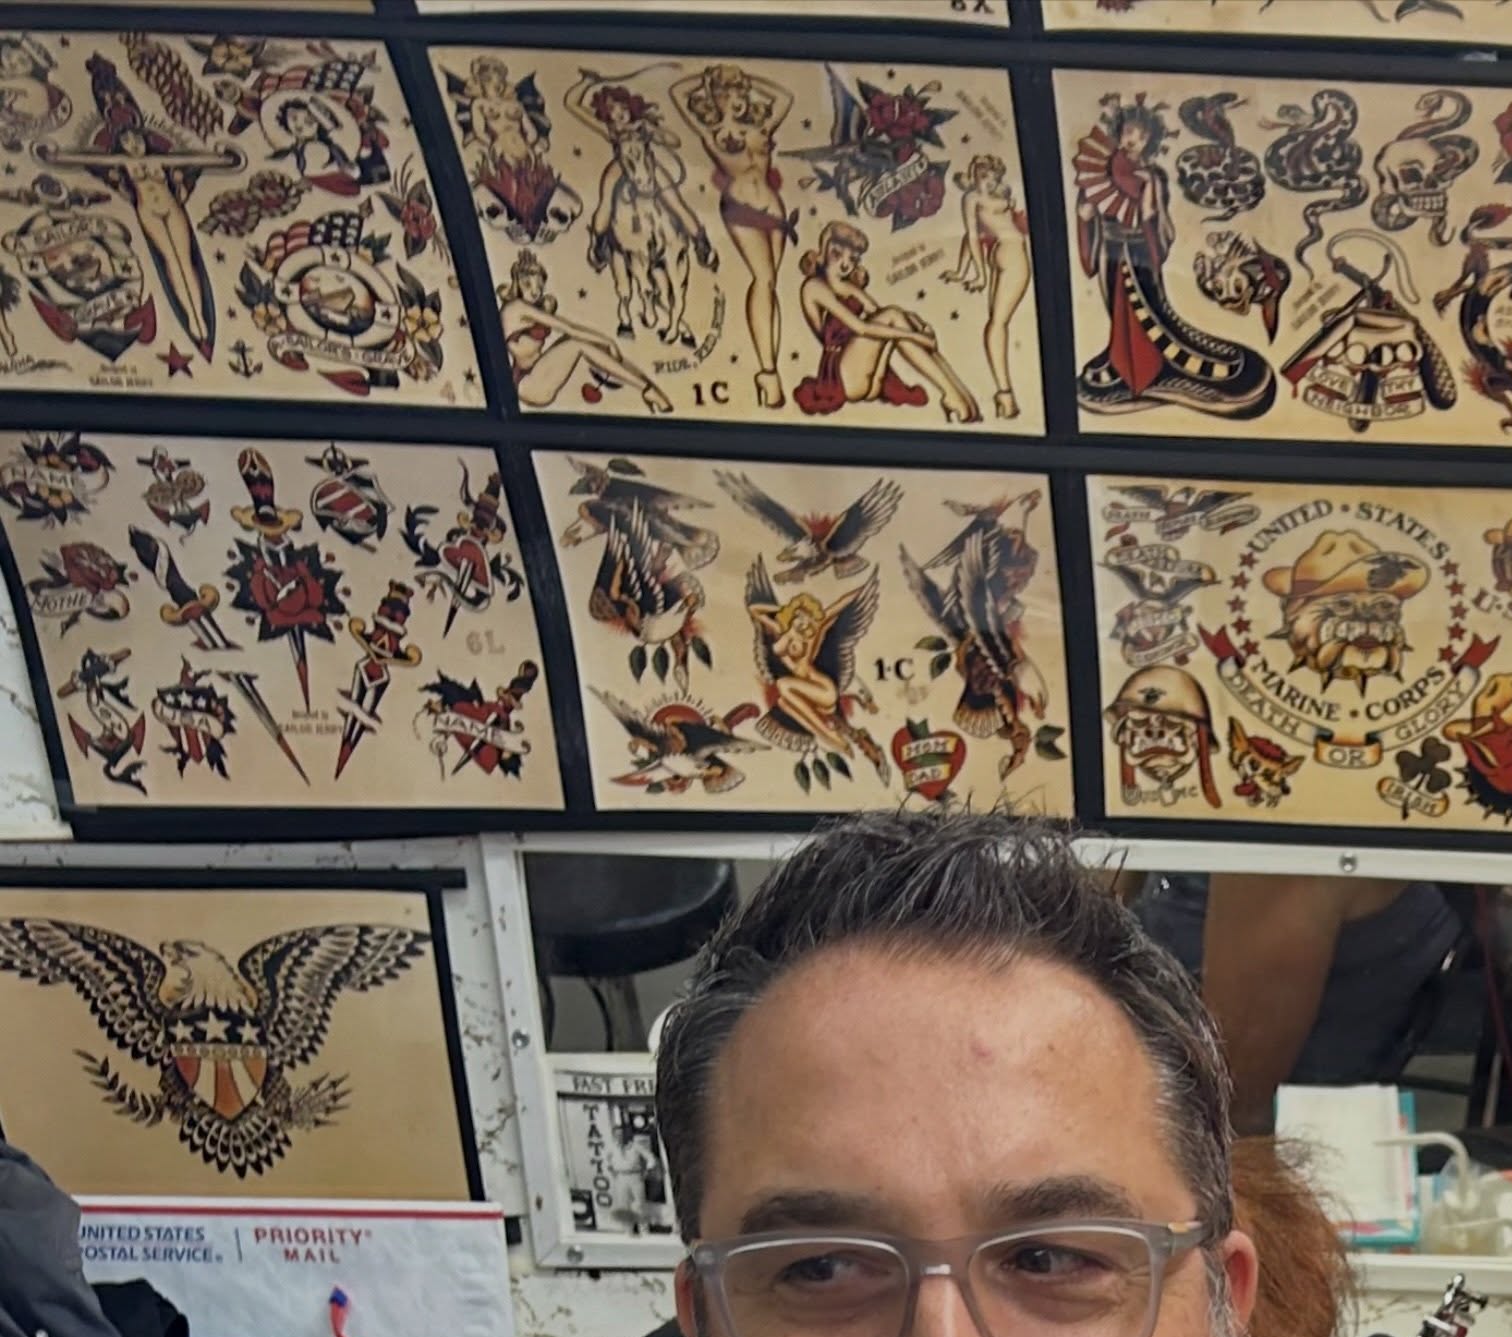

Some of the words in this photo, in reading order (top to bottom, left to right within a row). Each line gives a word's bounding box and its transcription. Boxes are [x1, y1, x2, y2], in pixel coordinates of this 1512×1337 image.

[1247, 499, 1334, 554] UNITED
[1356, 501, 1451, 560] STATES
[1254, 657, 1341, 722] MARINE
[1366, 666, 1446, 721] CORPS
[1228, 673, 1301, 737] DEATH
[1329, 750, 1366, 765] OR
[1395, 677, 1469, 740] GLORY
[903, 738, 951, 759] MOM
[908, 768, 942, 783] DAD
[583, 1103, 613, 1208] TATTOO
[144, 1226, 205, 1240] STATES
[254, 1227, 365, 1246] PRIORITY
[284, 1250, 341, 1264] MAIL
